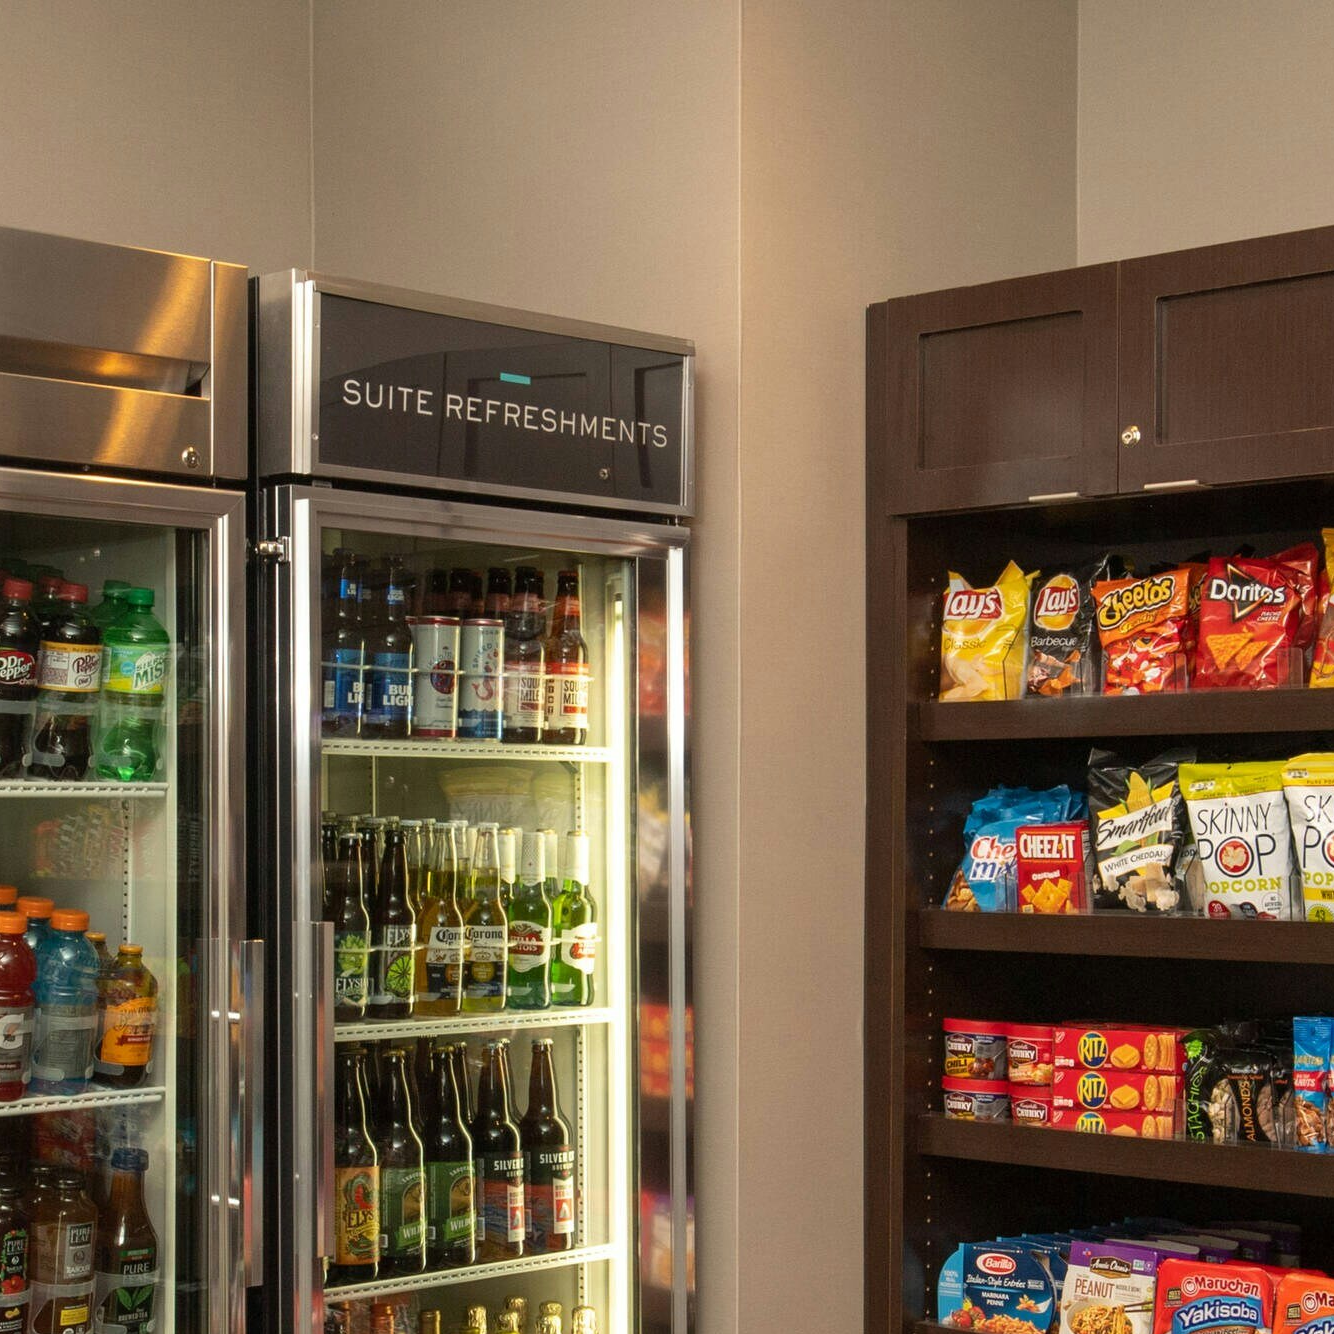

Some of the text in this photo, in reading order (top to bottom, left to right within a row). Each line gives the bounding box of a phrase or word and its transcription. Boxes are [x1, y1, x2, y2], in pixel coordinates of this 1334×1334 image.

[342, 380, 669, 448] SUITE REFRESHMENTS
[1098, 574, 1173, 626] Cheetos
[1210, 578, 1286, 604] Doritos
[944, 588, 1000, 620] Lay's
[1036, 585, 1079, 617] Lay's
[943, 637, 987, 651] Classic
[1030, 635, 1078, 648] Barbecue
[6, 655, 22, 668] Dr
[73, 657, 100, 675] Pepper
[1196, 801, 1272, 836] SKINNY
[1196, 833, 1277, 878] POP
[1103, 857, 1129, 874] WHITE
[466, 927, 504, 941] Corona
[1010, 1049, 1036, 1060] CHUNKY
[1080, 1037, 1107, 1064] RITZ
[1079, 1078, 1106, 1104] RITZ
[1016, 1107, 1045, 1119] CHUNKY
[1239, 1078, 1255, 1142] ALMONDS
[70, 1225, 92, 1236] PURE
[123, 1262, 150, 1275] PURE
[985, 1257, 1013, 1270] Barilla
[1074, 1278, 1115, 1299] PEANUT
[1194, 1275, 1259, 1297] Maruchan
[981, 1291, 1010, 1301] MARINARA
[986, 1299, 1005, 1307] PENNE
[1179, 1299, 1258, 1328] Yakisoba
